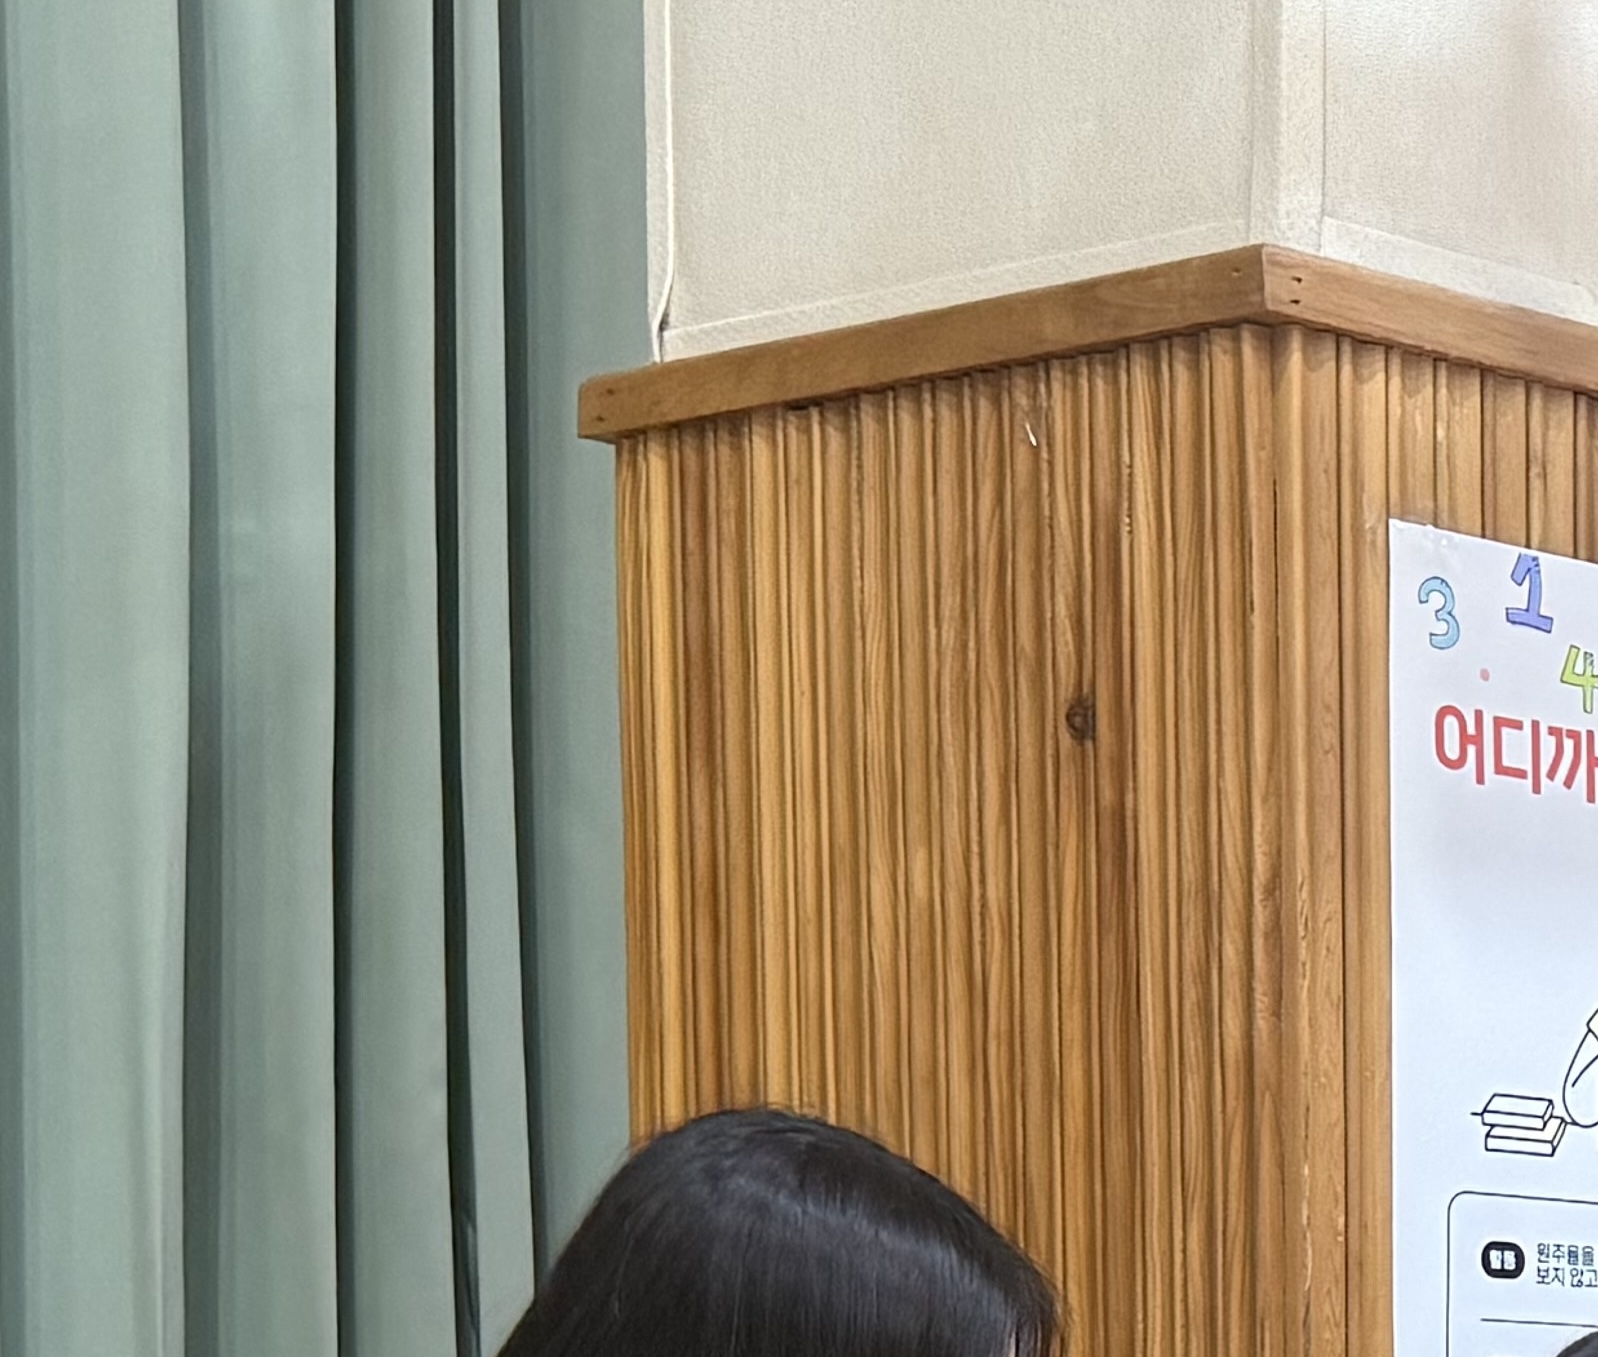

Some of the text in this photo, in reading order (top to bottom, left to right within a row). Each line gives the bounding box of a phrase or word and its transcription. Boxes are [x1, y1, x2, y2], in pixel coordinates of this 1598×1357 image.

[1418, 576, 1460, 650] 3
[1505, 552, 1553, 633] 1
[1537, 1242, 1595, 1267] 원주율을
[1536, 1266, 1565, 1287] 보지
[1569, 1268, 1598, 1288] 않고
